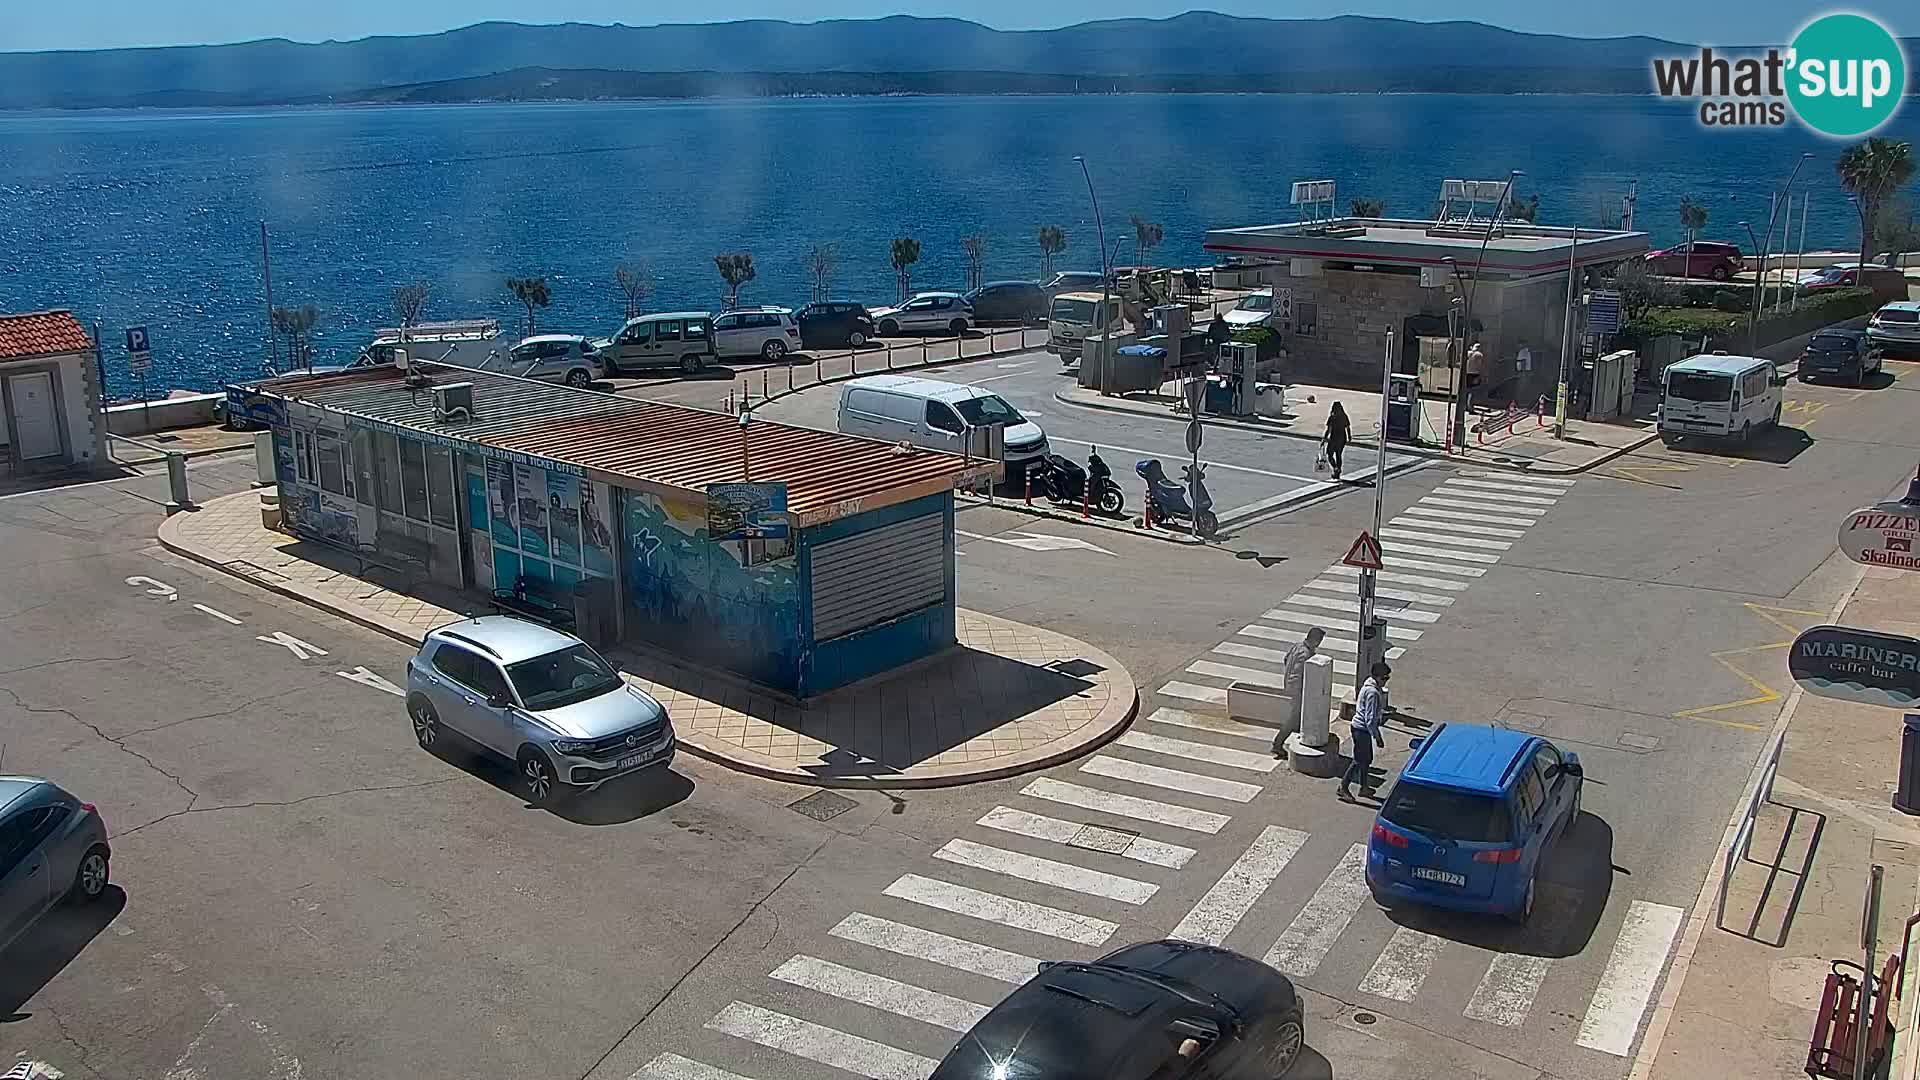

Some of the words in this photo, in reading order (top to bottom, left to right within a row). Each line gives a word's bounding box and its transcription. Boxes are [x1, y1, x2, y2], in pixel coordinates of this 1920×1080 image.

[131, 330, 144, 349] P
[479, 445, 494, 457] BUS
[495, 449, 528, 464] STATION
[529, 456, 555, 471] TICKET
[556, 463, 584, 477] OFFICE
[1849, 514, 1920, 533] PIZZE
[1801, 641, 1920, 673] MARINER
[1871, 665, 1897, 680] bar
